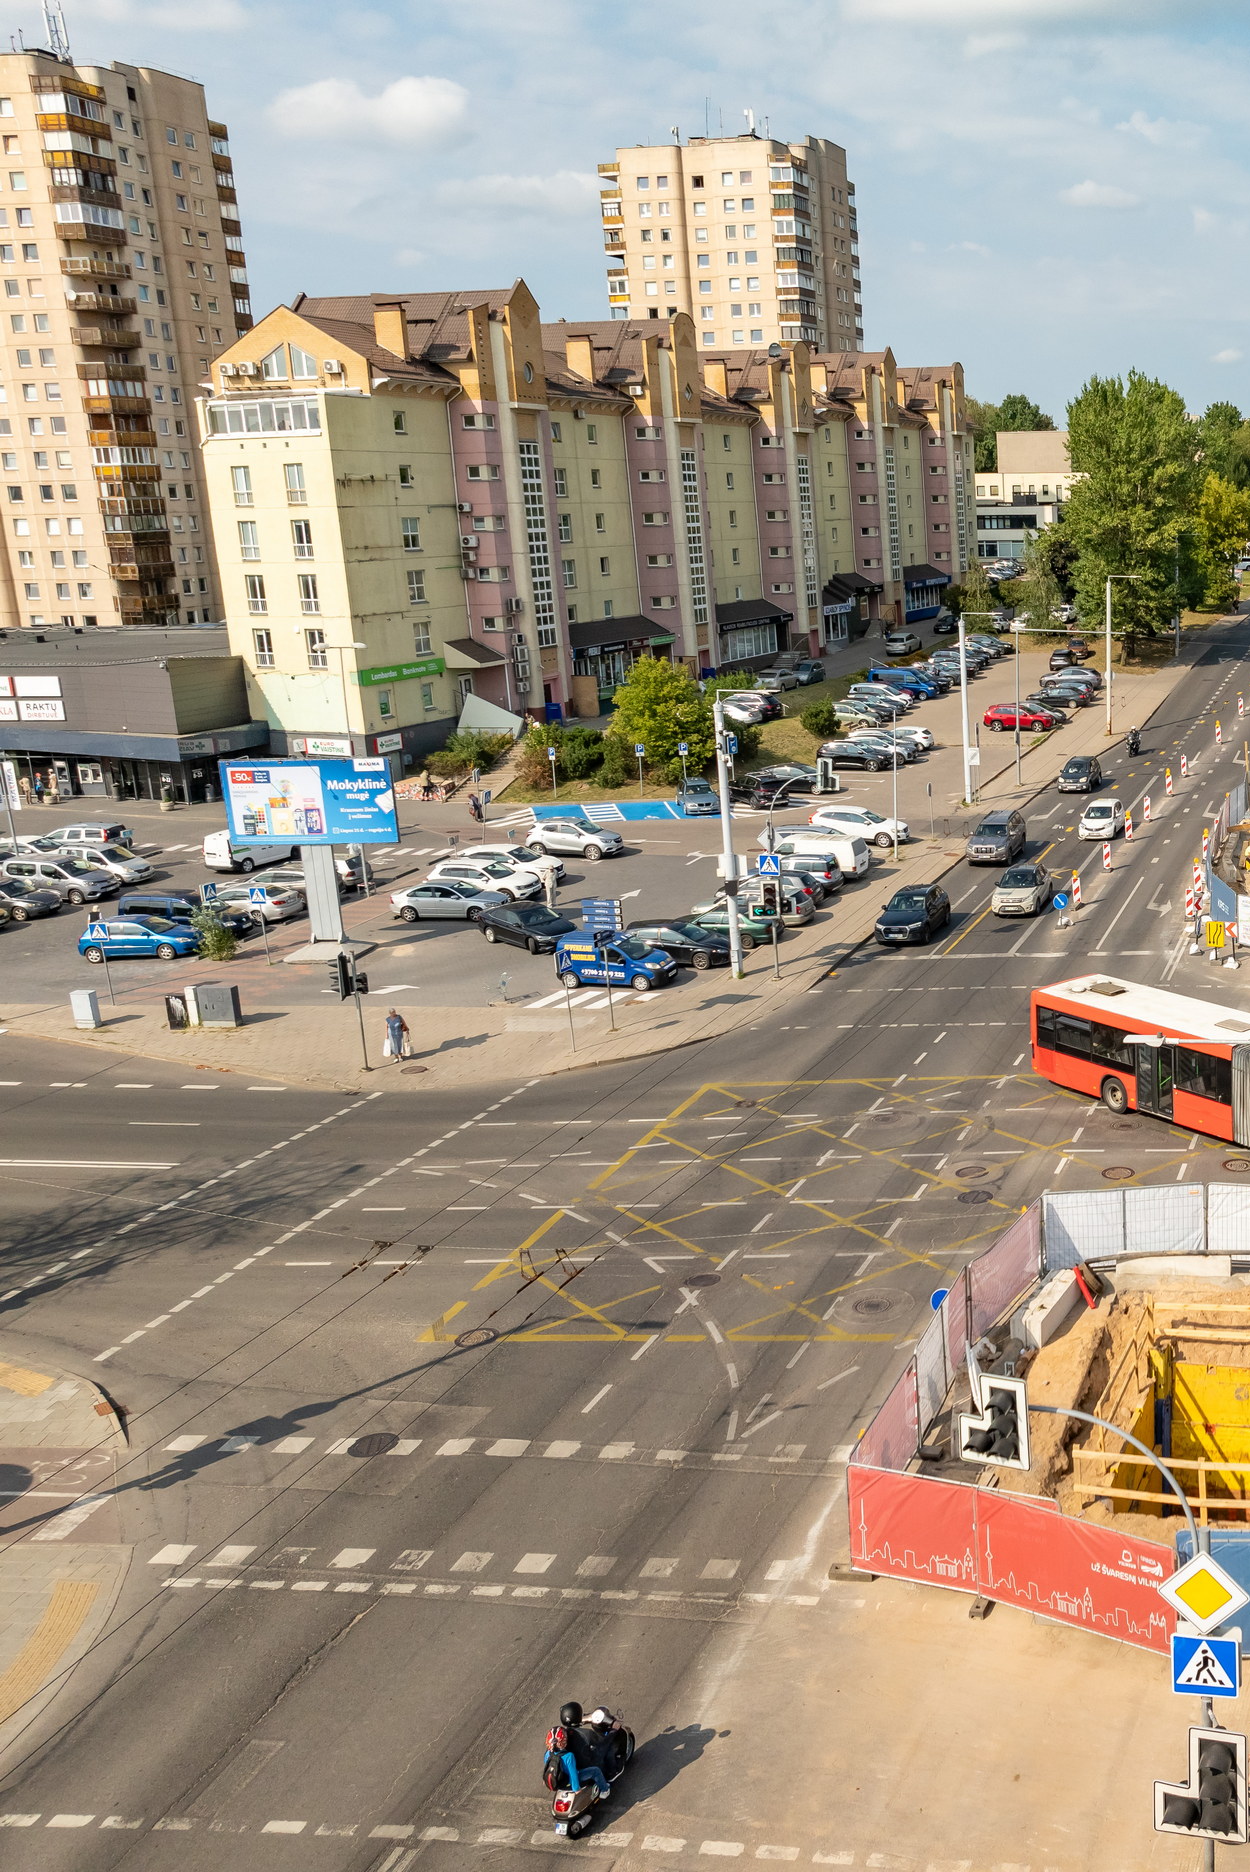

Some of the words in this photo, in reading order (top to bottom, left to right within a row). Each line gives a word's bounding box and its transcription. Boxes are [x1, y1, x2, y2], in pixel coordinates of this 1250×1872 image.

[371, 670, 398, 681] Lombardas
[402, 666, 426, 676] Banknote
[26, 703, 57, 711] RAKTŲ
[327, 779, 387, 792] Mokyklinė
[346, 791, 370, 801] mugė
[1118, 1560, 1137, 1569] VILNIUS
[1091, 1562, 1100, 1573] UŽ
[1101, 1564, 1137, 1585] ŠVARESNĮ
